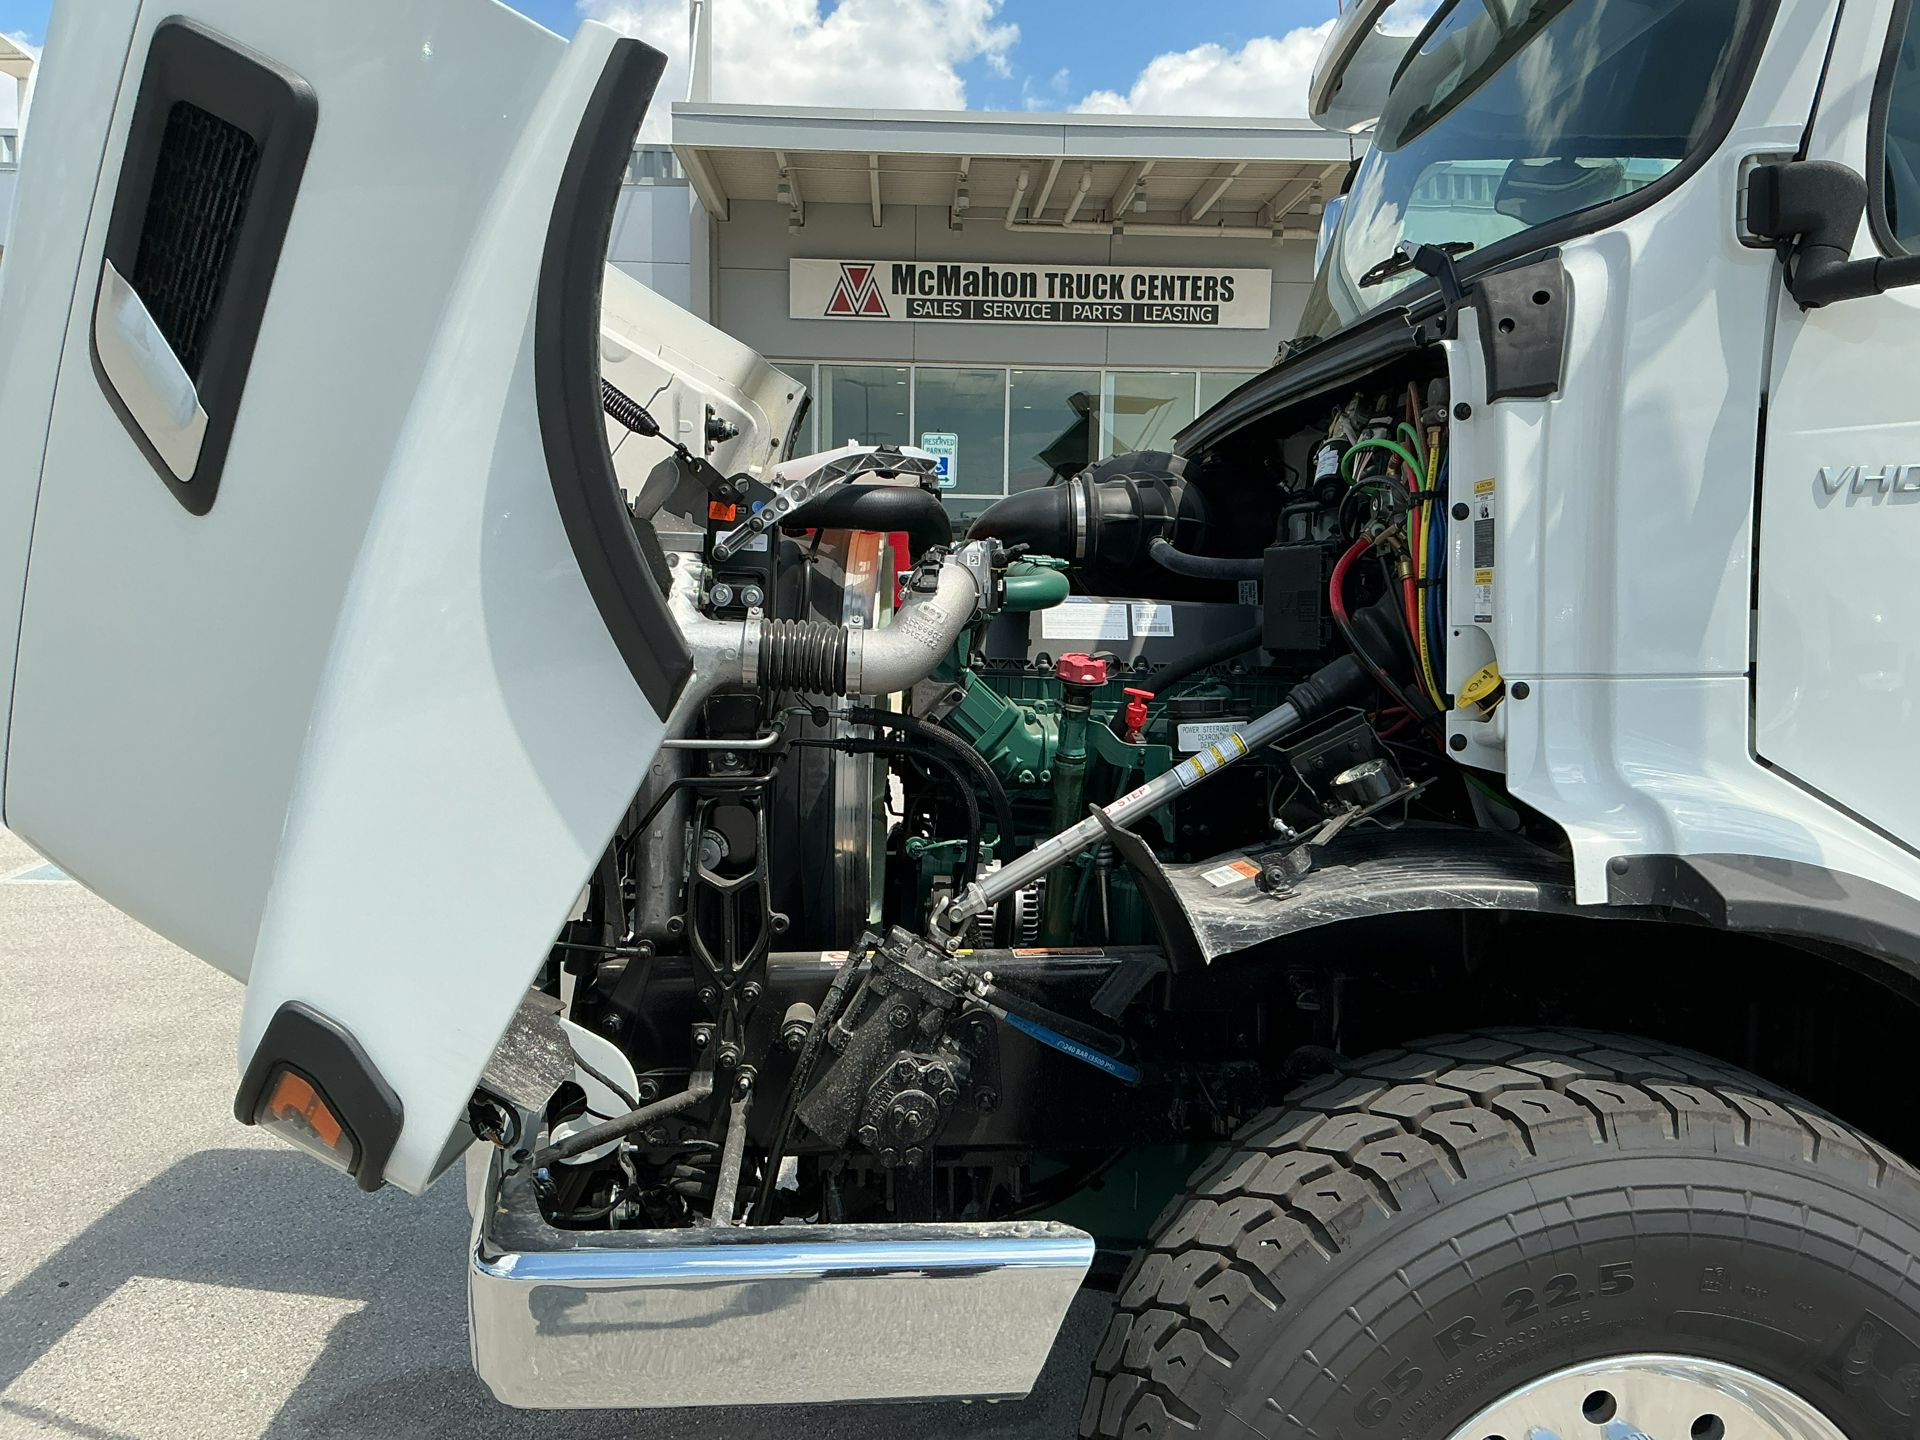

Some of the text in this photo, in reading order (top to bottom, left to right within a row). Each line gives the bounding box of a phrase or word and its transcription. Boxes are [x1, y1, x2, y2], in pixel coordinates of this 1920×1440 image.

[891, 264, 1235, 302] McMahon TRUCK CENTERS
[913, 301, 1213, 322] SALES SERVICE PARTS LEASING
[924, 438, 954, 446] RESERVED
[926, 447, 953, 455] PARKING
[1183, 726, 1199, 734] POWER
[1203, 724, 1229, 733] STEERING
[1198, 733, 1219, 741] DEXRON
[1117, 787, 1146, 807] STEP
[1063, 1044, 1075, 1053] 240
[1076, 1048, 1088, 1059] BAR
[1352, 1357, 1424, 1429] 65
[1433, 1315, 1488, 1362] R
[1502, 1261, 1635, 1328] 22.5
